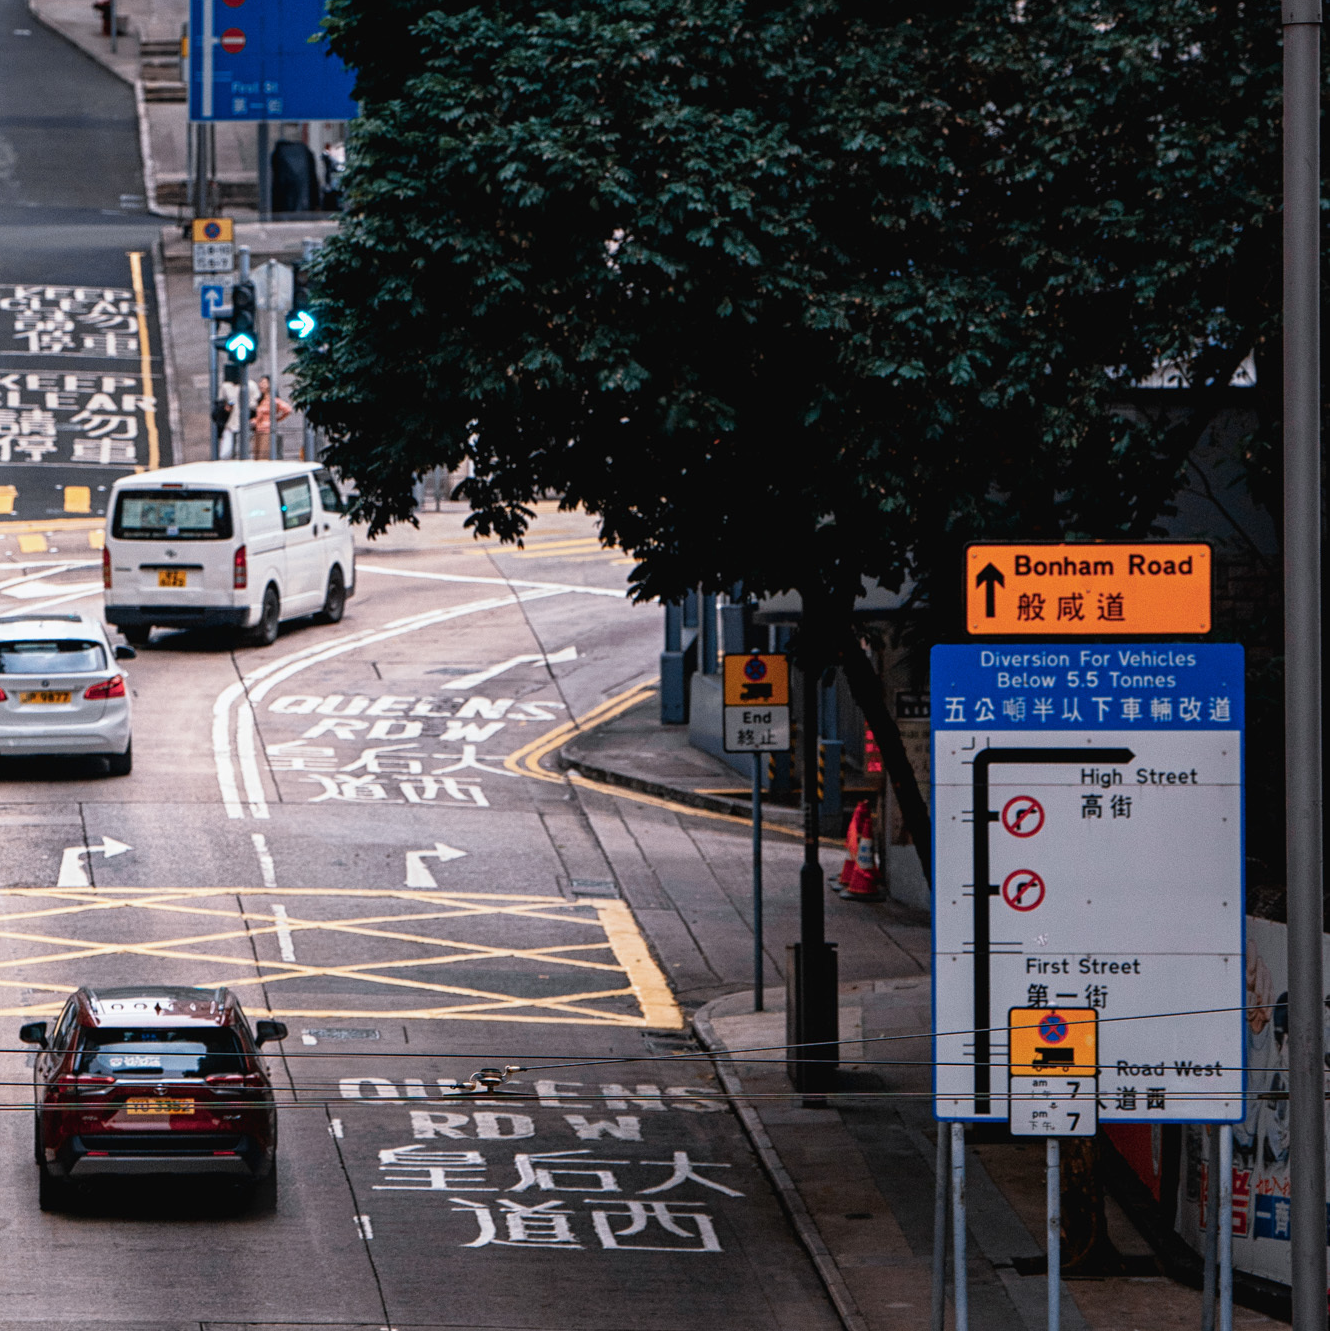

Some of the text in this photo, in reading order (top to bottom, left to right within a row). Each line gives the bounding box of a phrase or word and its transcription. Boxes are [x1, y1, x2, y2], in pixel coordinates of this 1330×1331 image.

[15, 286, 133, 302] KEEP
[1015, 554, 1193, 576] Bonham Road
[1017, 592, 1125, 622] 般咸道
[981, 650, 1196, 667] Diversion For Vehicles
[998, 671, 1177, 688] Below 5.5 Tonnes
[268, 695, 566, 721] QUEENS
[743, 712, 772, 724] End
[945, 696, 1232, 723] 五公噸半以下車輛改道
[302, 719, 507, 742] RD W
[737, 729, 777, 746] 終止
[266, 740, 522, 778] 皇后大
[1080, 768, 1199, 789] High Street
[299, 774, 490, 807] 道西
[1080, 794, 1133, 819] 高街
[1026, 958, 1141, 975] First Street
[1027, 984, 1108, 1008] 第一街
[1117, 1061, 1223, 1077] Road West
[1066, 1081, 1081, 1098] 7
[410, 1111, 644, 1142] RD W
[1032, 1111, 1081, 1131] pm 7
[371, 1144, 746, 1198] 皇后大
[448, 1198, 724, 1252] 道西
